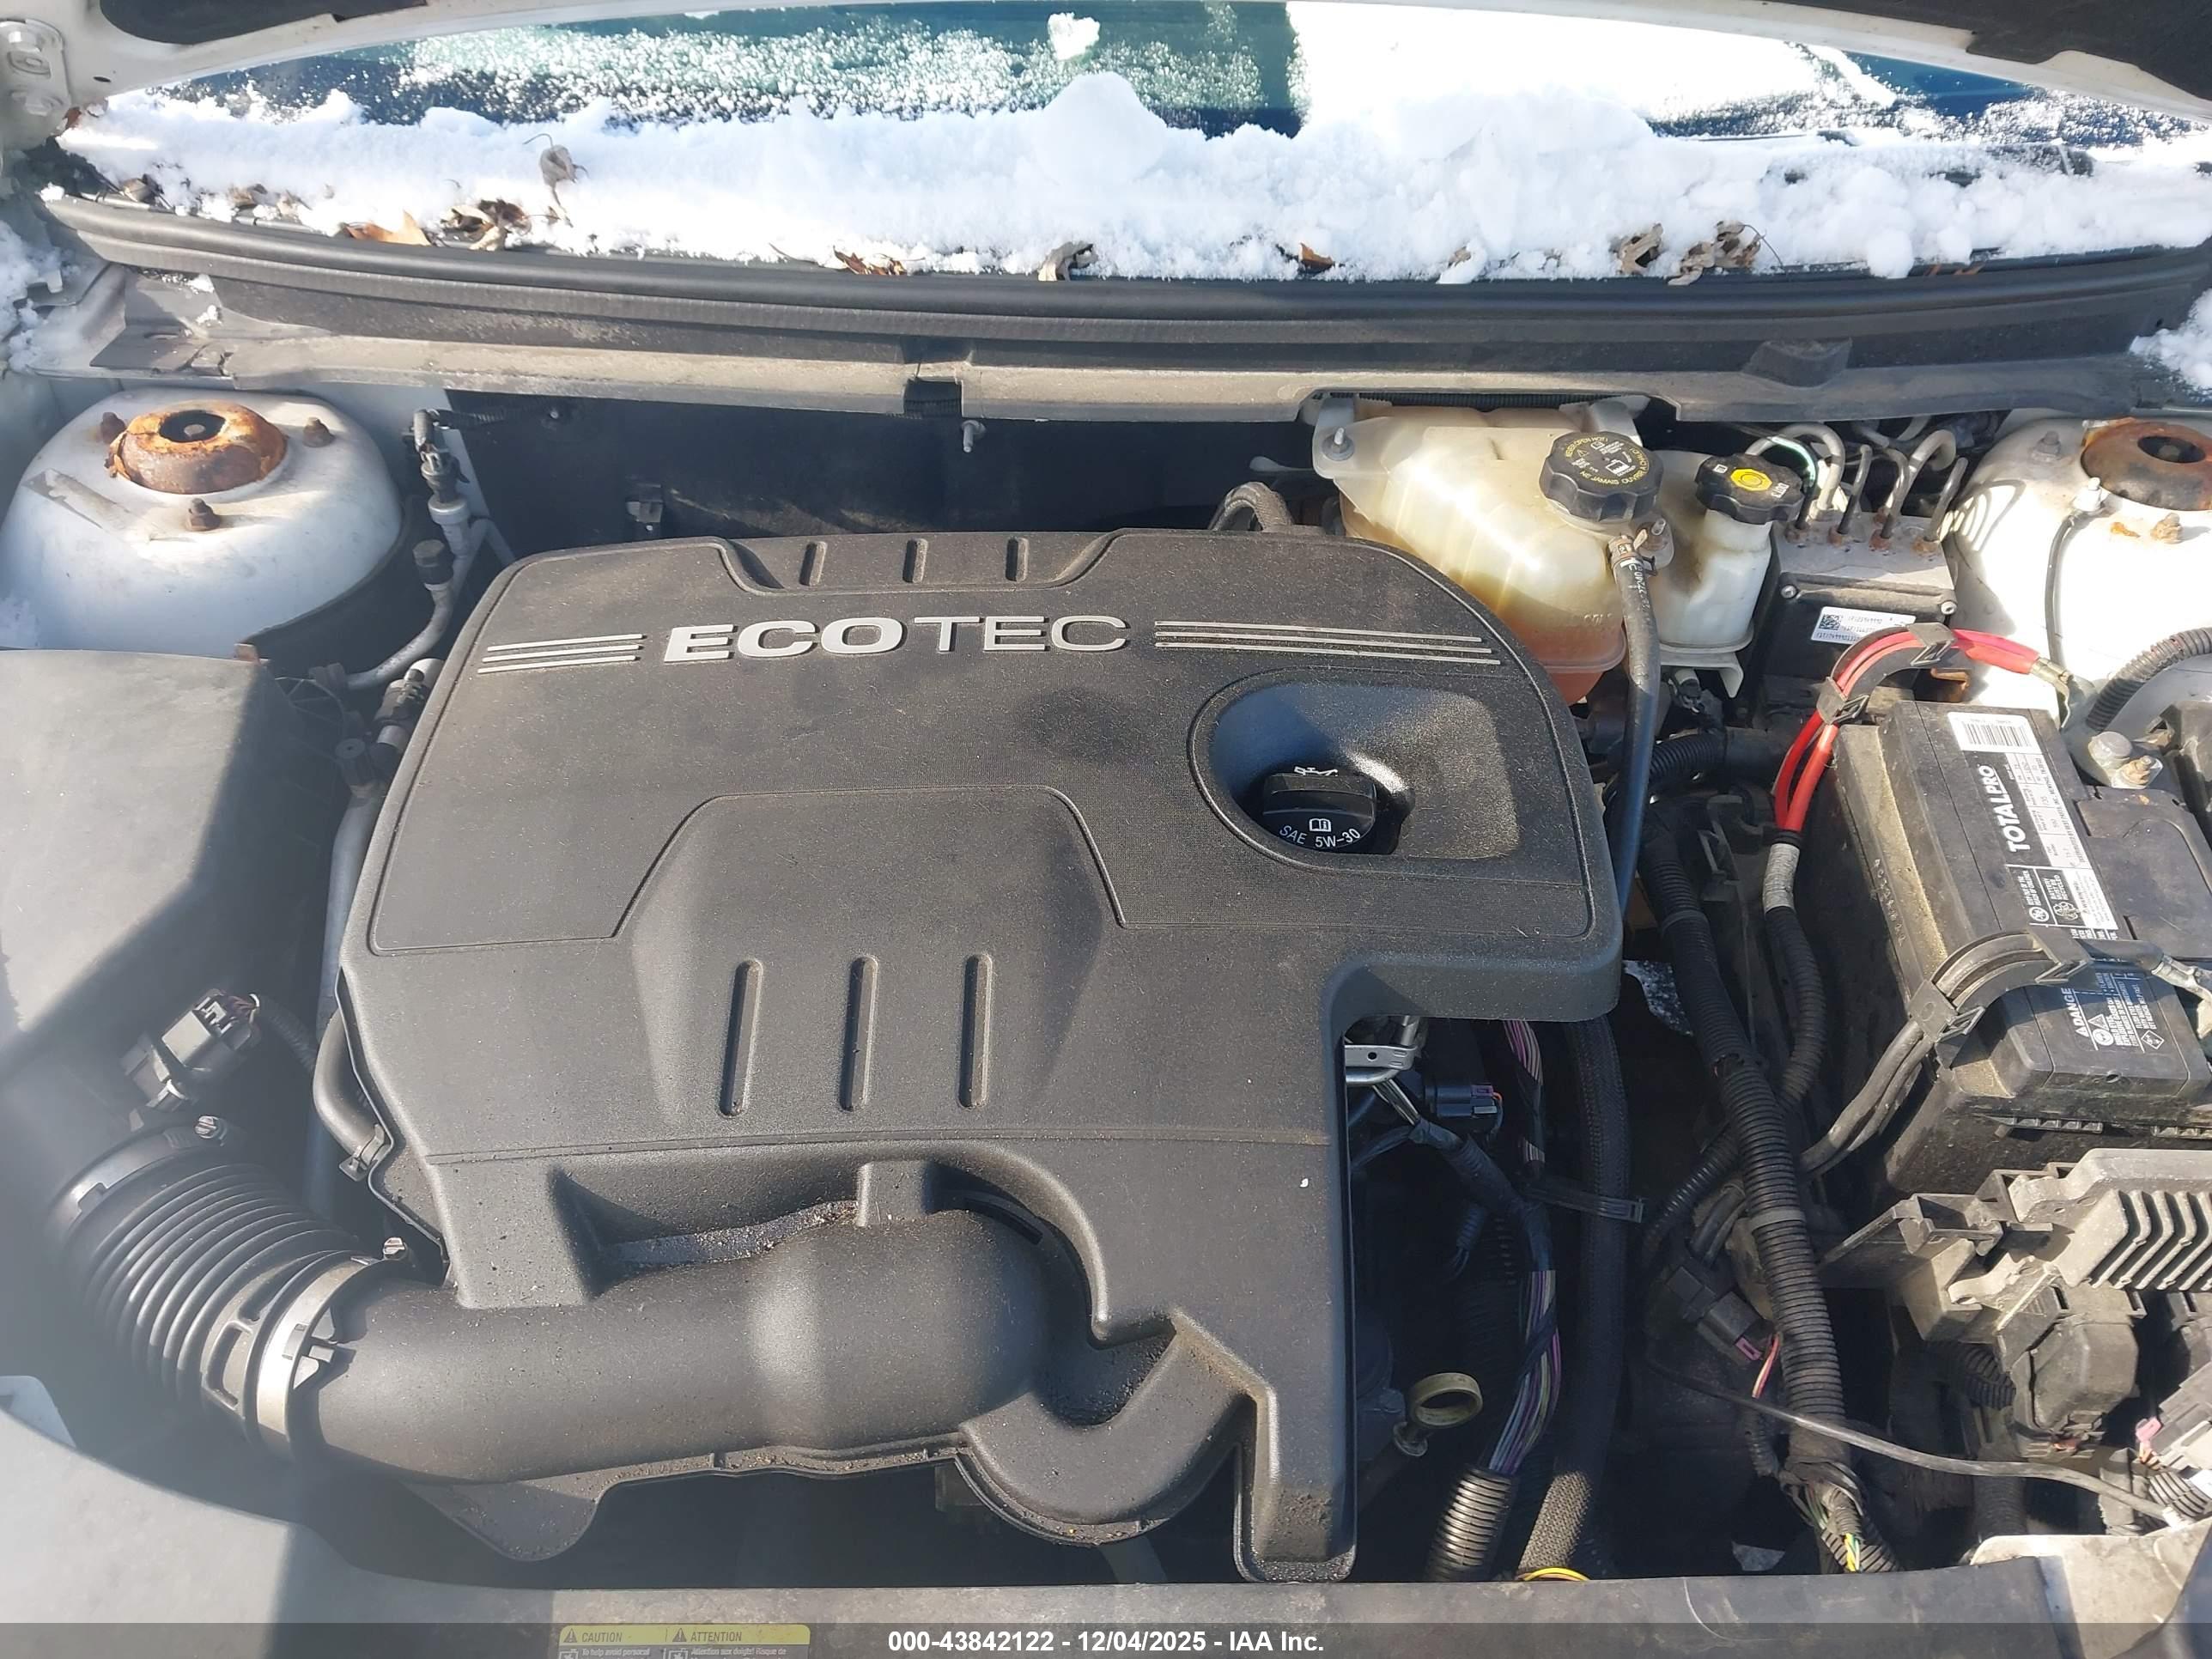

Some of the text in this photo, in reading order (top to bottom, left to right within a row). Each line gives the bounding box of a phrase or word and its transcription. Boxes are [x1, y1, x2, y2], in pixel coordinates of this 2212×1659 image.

[664, 615, 1127, 664] ECOTEC
[1978, 765, 2031, 853] TOTALPRO
[1279, 825, 1361, 848] SAE 5W-30
[2044, 878, 2057, 900] BATTERY
[2054, 874, 2069, 900] RECYCLED
[2061, 988, 2086, 1026] DANGE
[581, 1632, 623, 1643] CAUTION
[690, 1631, 743, 1642] ATTENTION
[591, 1649, 604, 1657] help
